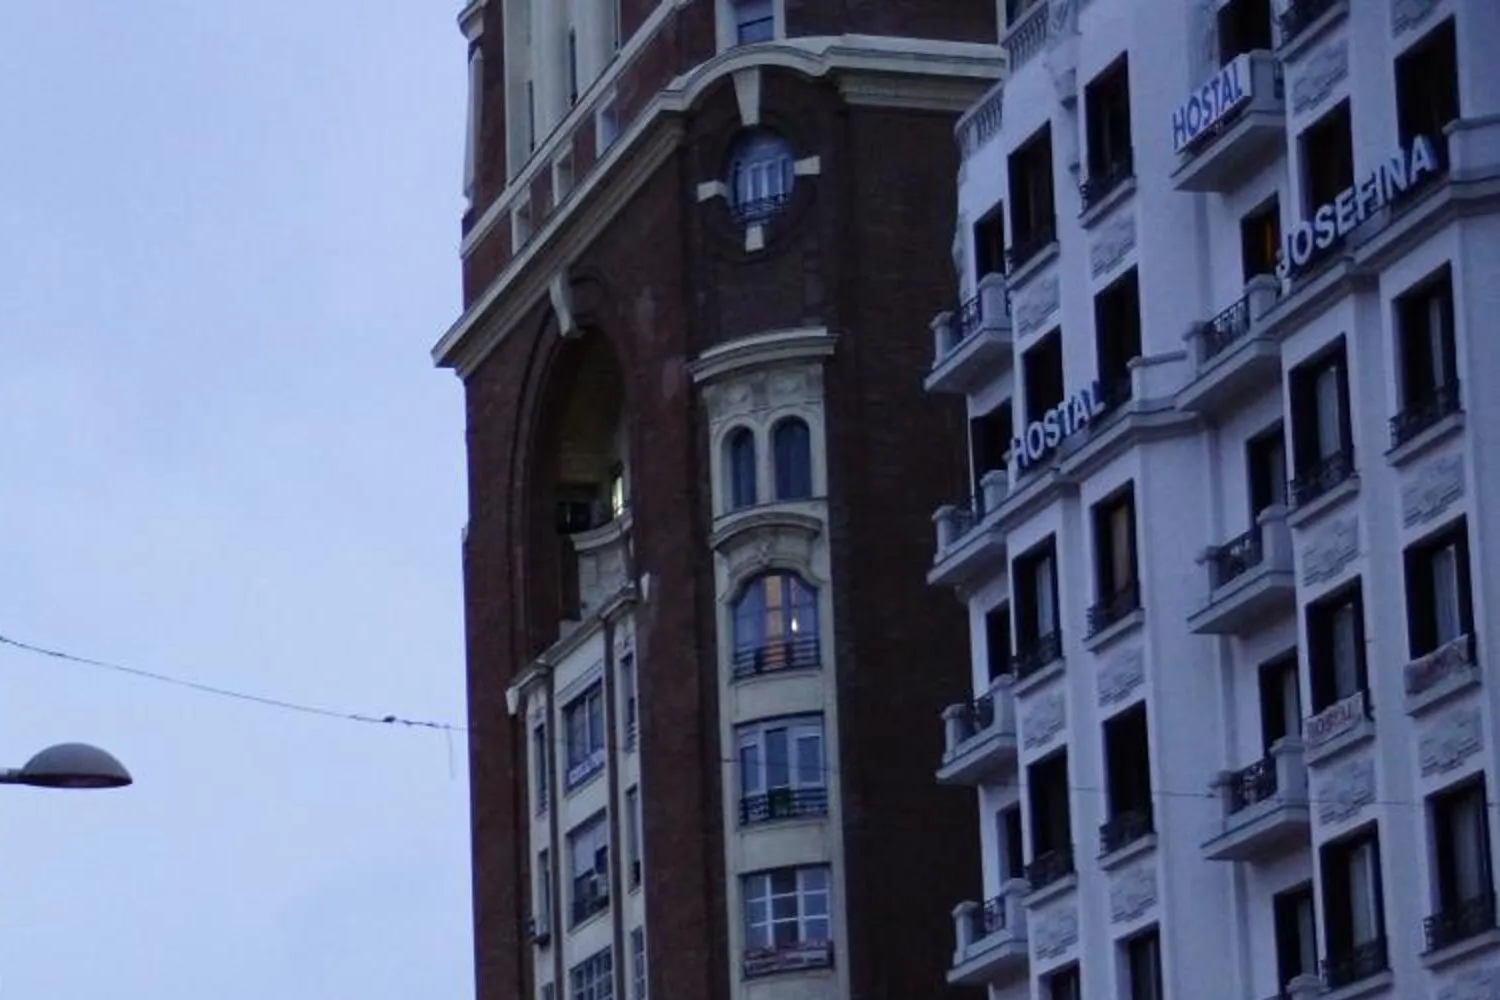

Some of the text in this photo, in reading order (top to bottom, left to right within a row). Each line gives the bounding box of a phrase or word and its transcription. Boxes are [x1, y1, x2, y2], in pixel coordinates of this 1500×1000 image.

[1172, 62, 1243, 150] HOSTAL
[1276, 134, 1435, 280] JOSEFINA
[1009, 381, 1106, 473] HOSTAL
